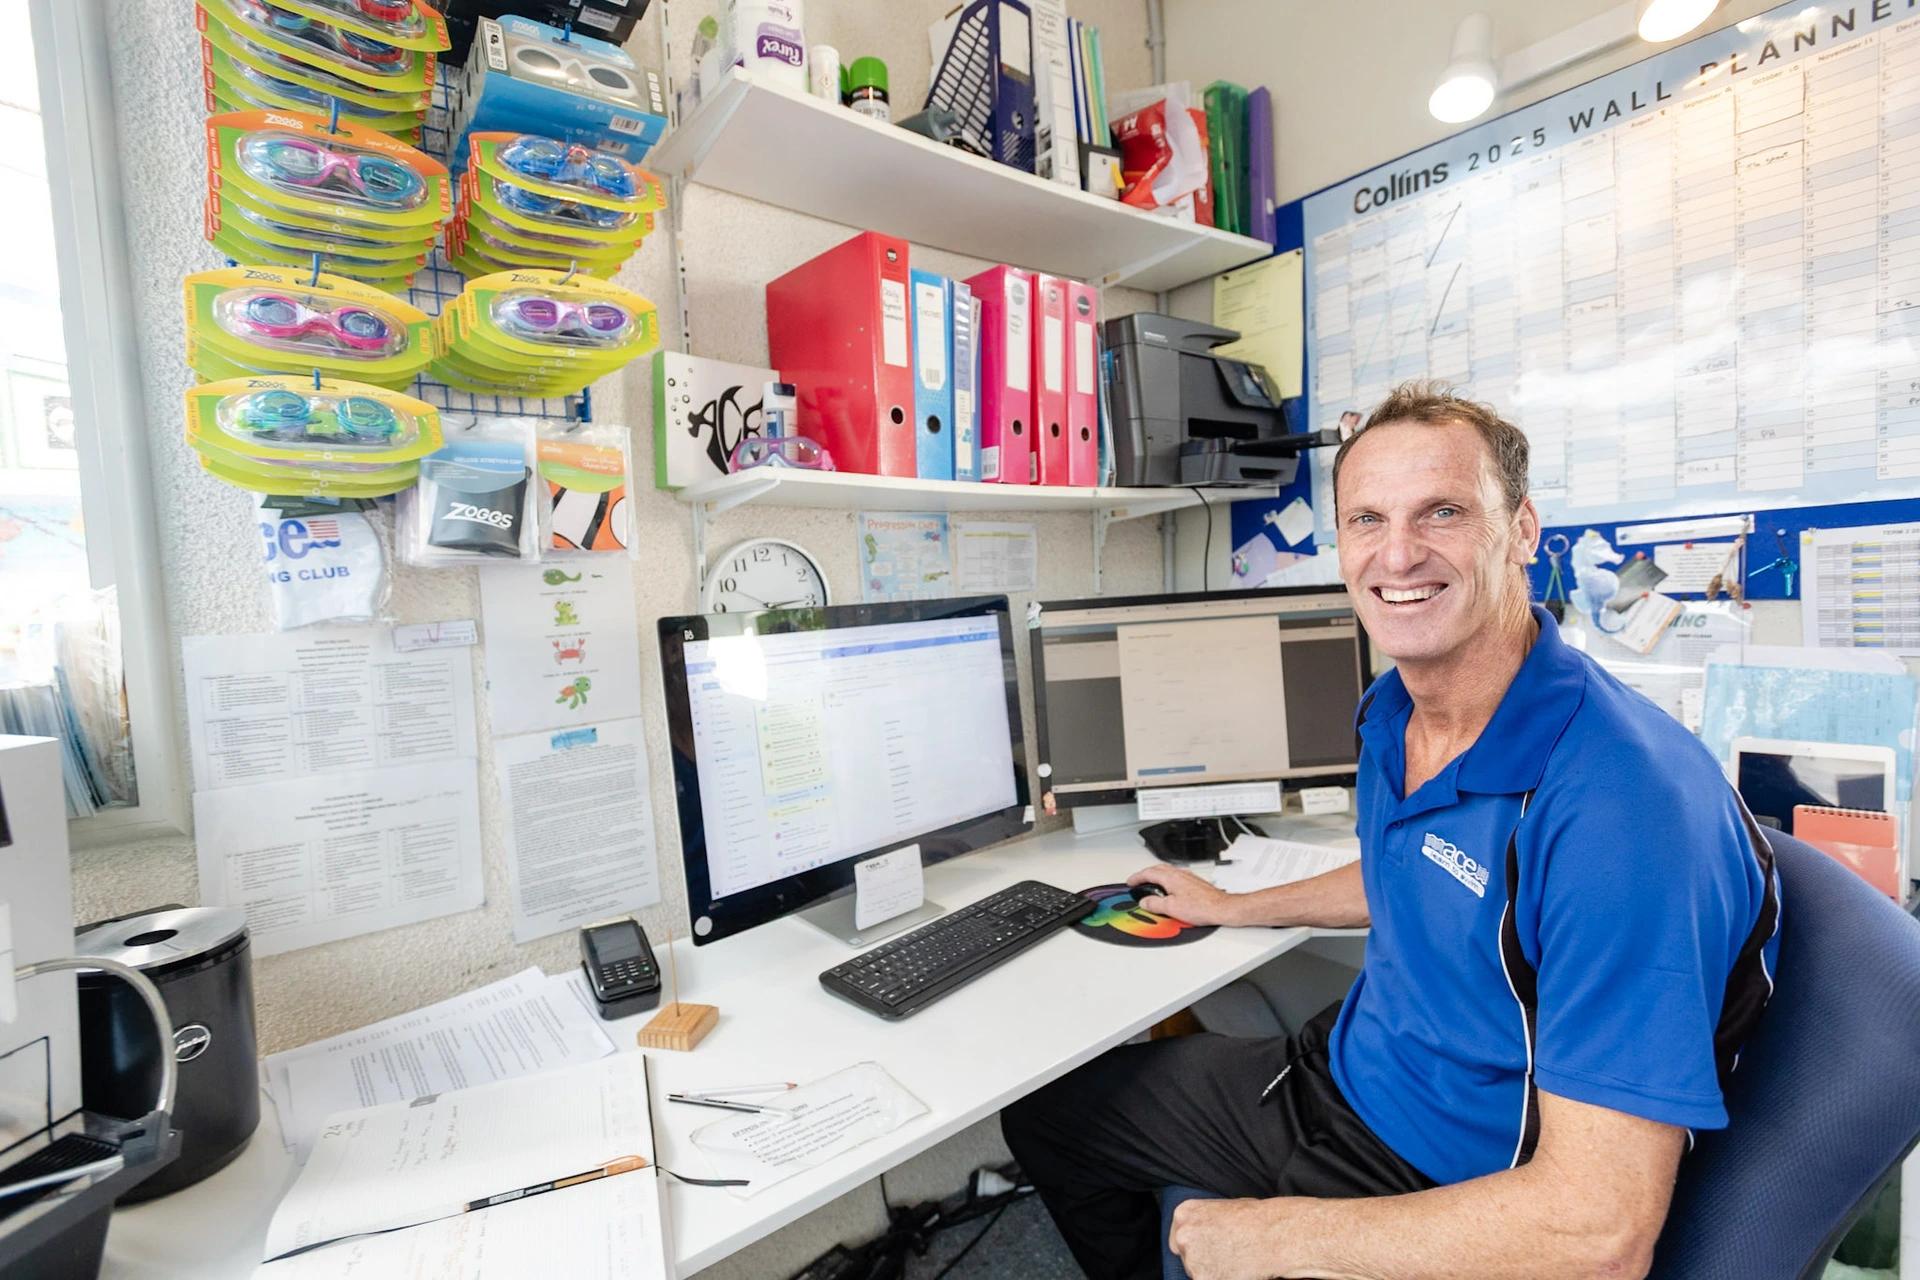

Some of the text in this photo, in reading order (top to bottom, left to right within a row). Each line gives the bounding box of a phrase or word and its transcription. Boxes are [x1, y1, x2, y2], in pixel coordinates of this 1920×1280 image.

[1354, 0, 1916, 215] Collins 2025 WALL PLANNE
[441, 502, 514, 530] ZOGGS
[752, 547, 772, 563] 12
[782, 553, 788, 567] 1
[297, 566, 351, 581] CLUB
[734, 558, 748, 573] 11
[796, 567, 808, 583] 2
[719, 577, 737, 593] 10
[1668, 614, 1708, 628] ING
